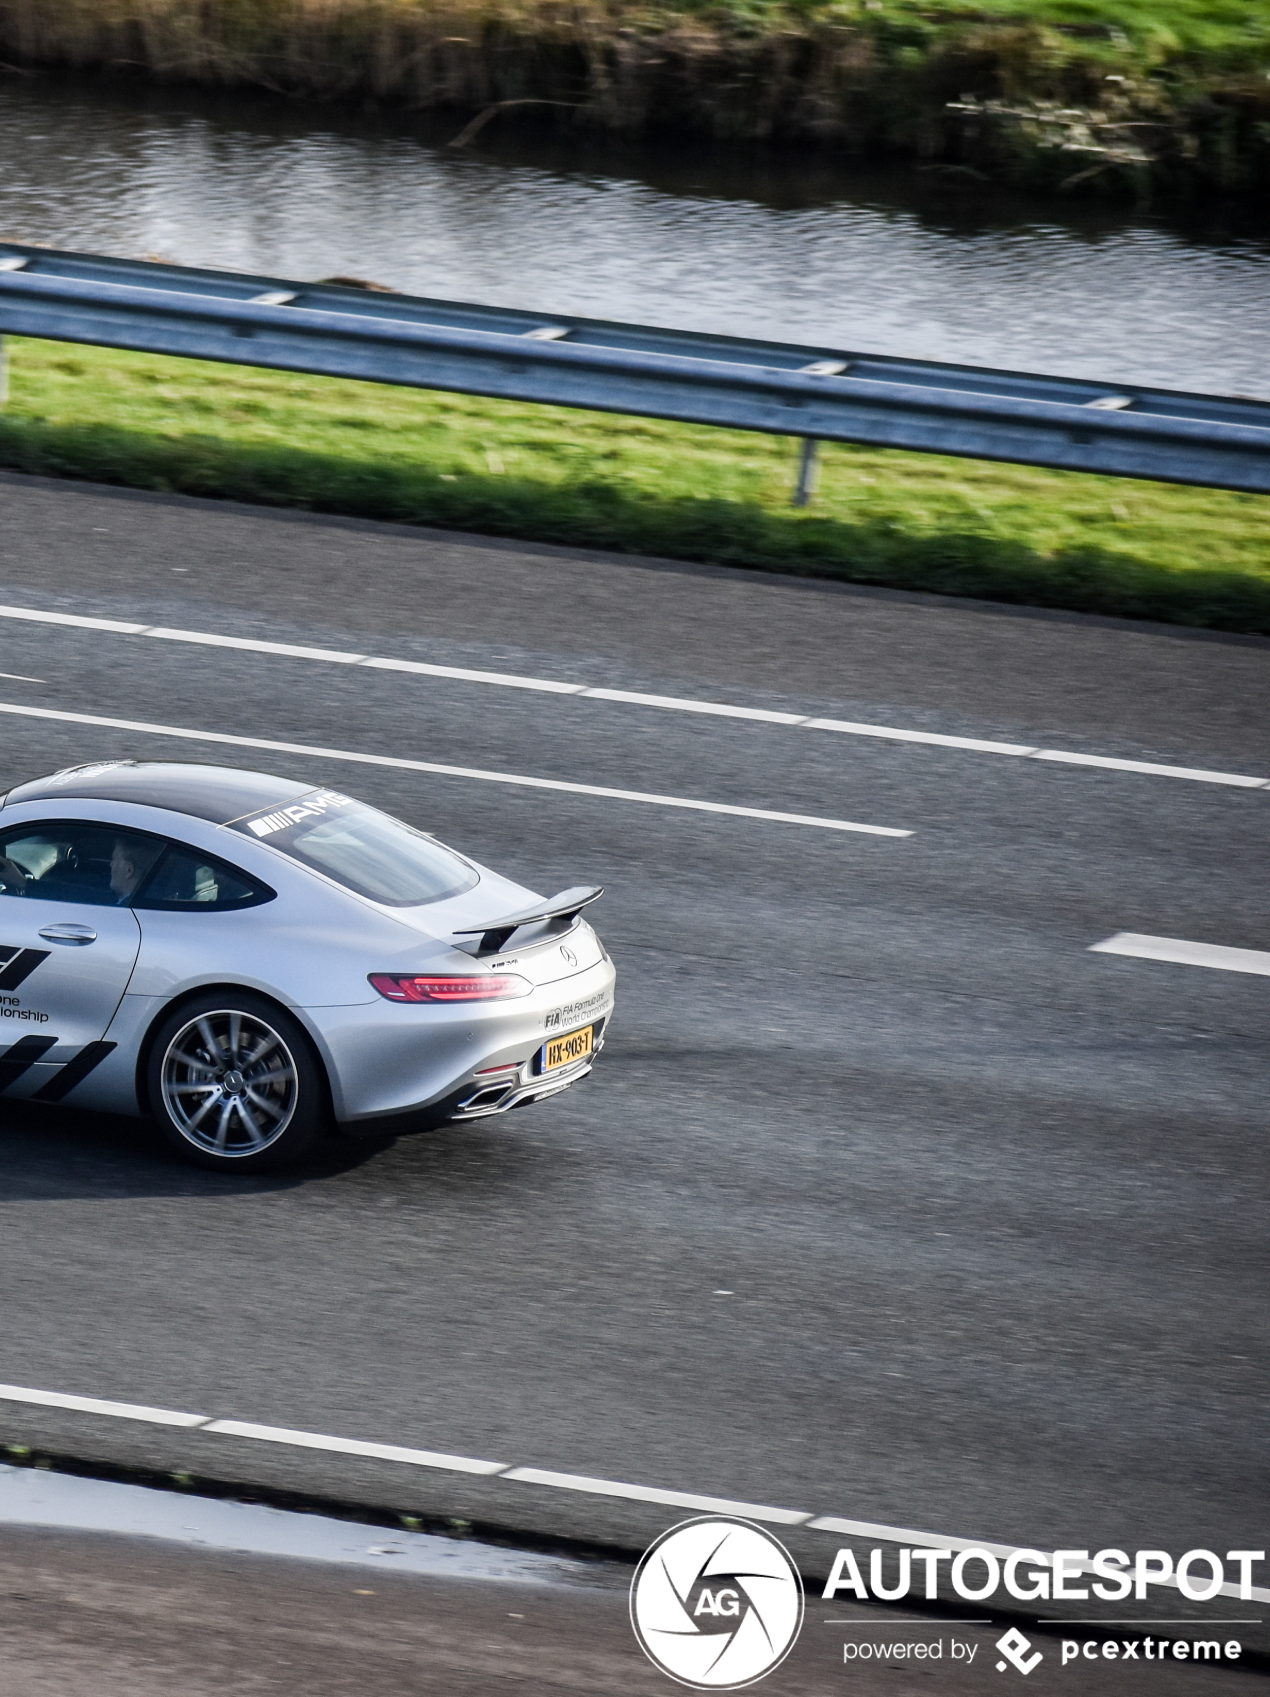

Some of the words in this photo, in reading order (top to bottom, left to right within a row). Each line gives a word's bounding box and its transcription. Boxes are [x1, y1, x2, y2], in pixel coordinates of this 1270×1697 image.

[282, 792, 355, 824] AMG
[563, 1004, 573, 1016] FIA
[548, 1031, 590, 1067] HX-903-T
